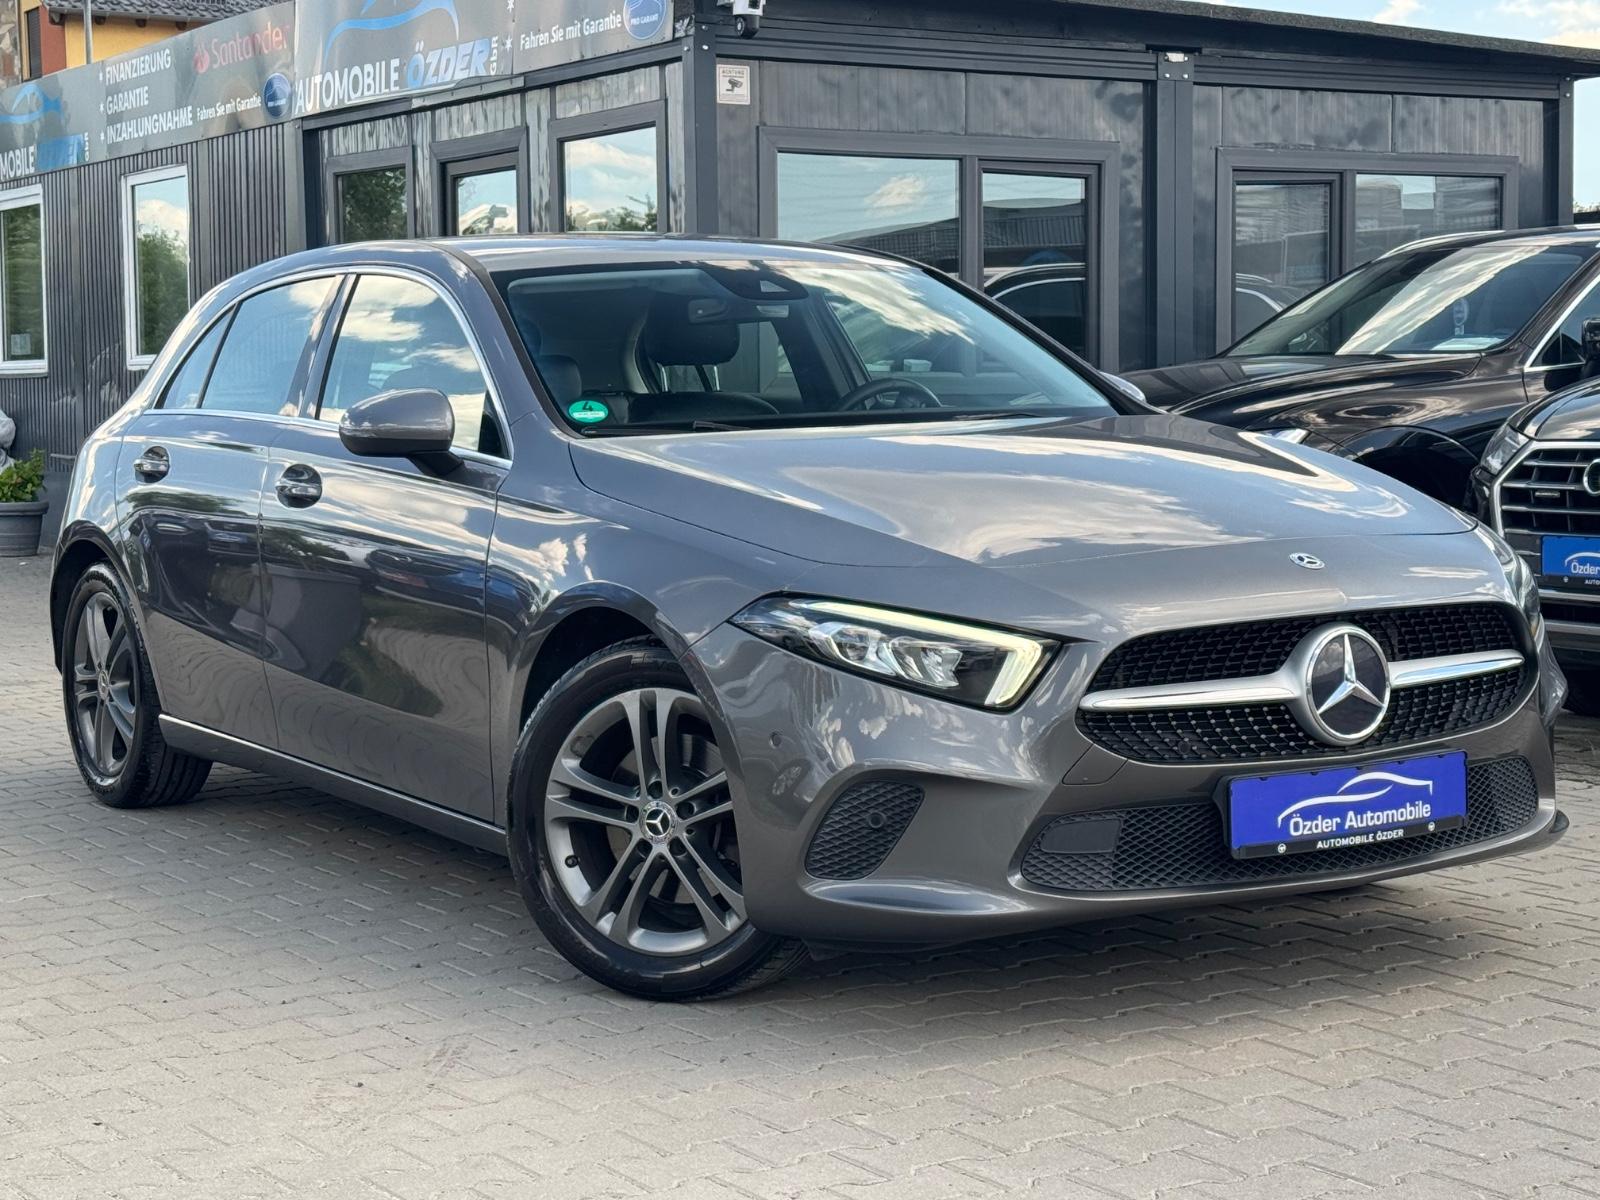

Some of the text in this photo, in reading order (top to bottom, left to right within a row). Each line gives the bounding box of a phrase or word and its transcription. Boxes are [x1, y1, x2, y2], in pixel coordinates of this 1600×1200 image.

[211, 21, 290, 69] Santander
[520, 10, 622, 50] Fahren Sie mit Garantie
[105, 48, 171, 86] FINANZIERUNG
[490, 36, 499, 76] GbR
[295, 38, 492, 115] AUTOMOBILE ÖZDER
[106, 86, 149, 115] GARANTIE
[197, 105, 216, 121] Fahren
[216, 101, 226, 117] Sie
[236, 92, 262, 112] Garantie
[107, 105, 193, 145] INZAHLUNGNAHME
[582, 401, 594, 411] 4
[1571, 560, 1600, 575] Özder
[1289, 800, 1432, 836] Özder Automobile
[1316, 829, 1404, 849] AUTOMOBILE ÖZDER
